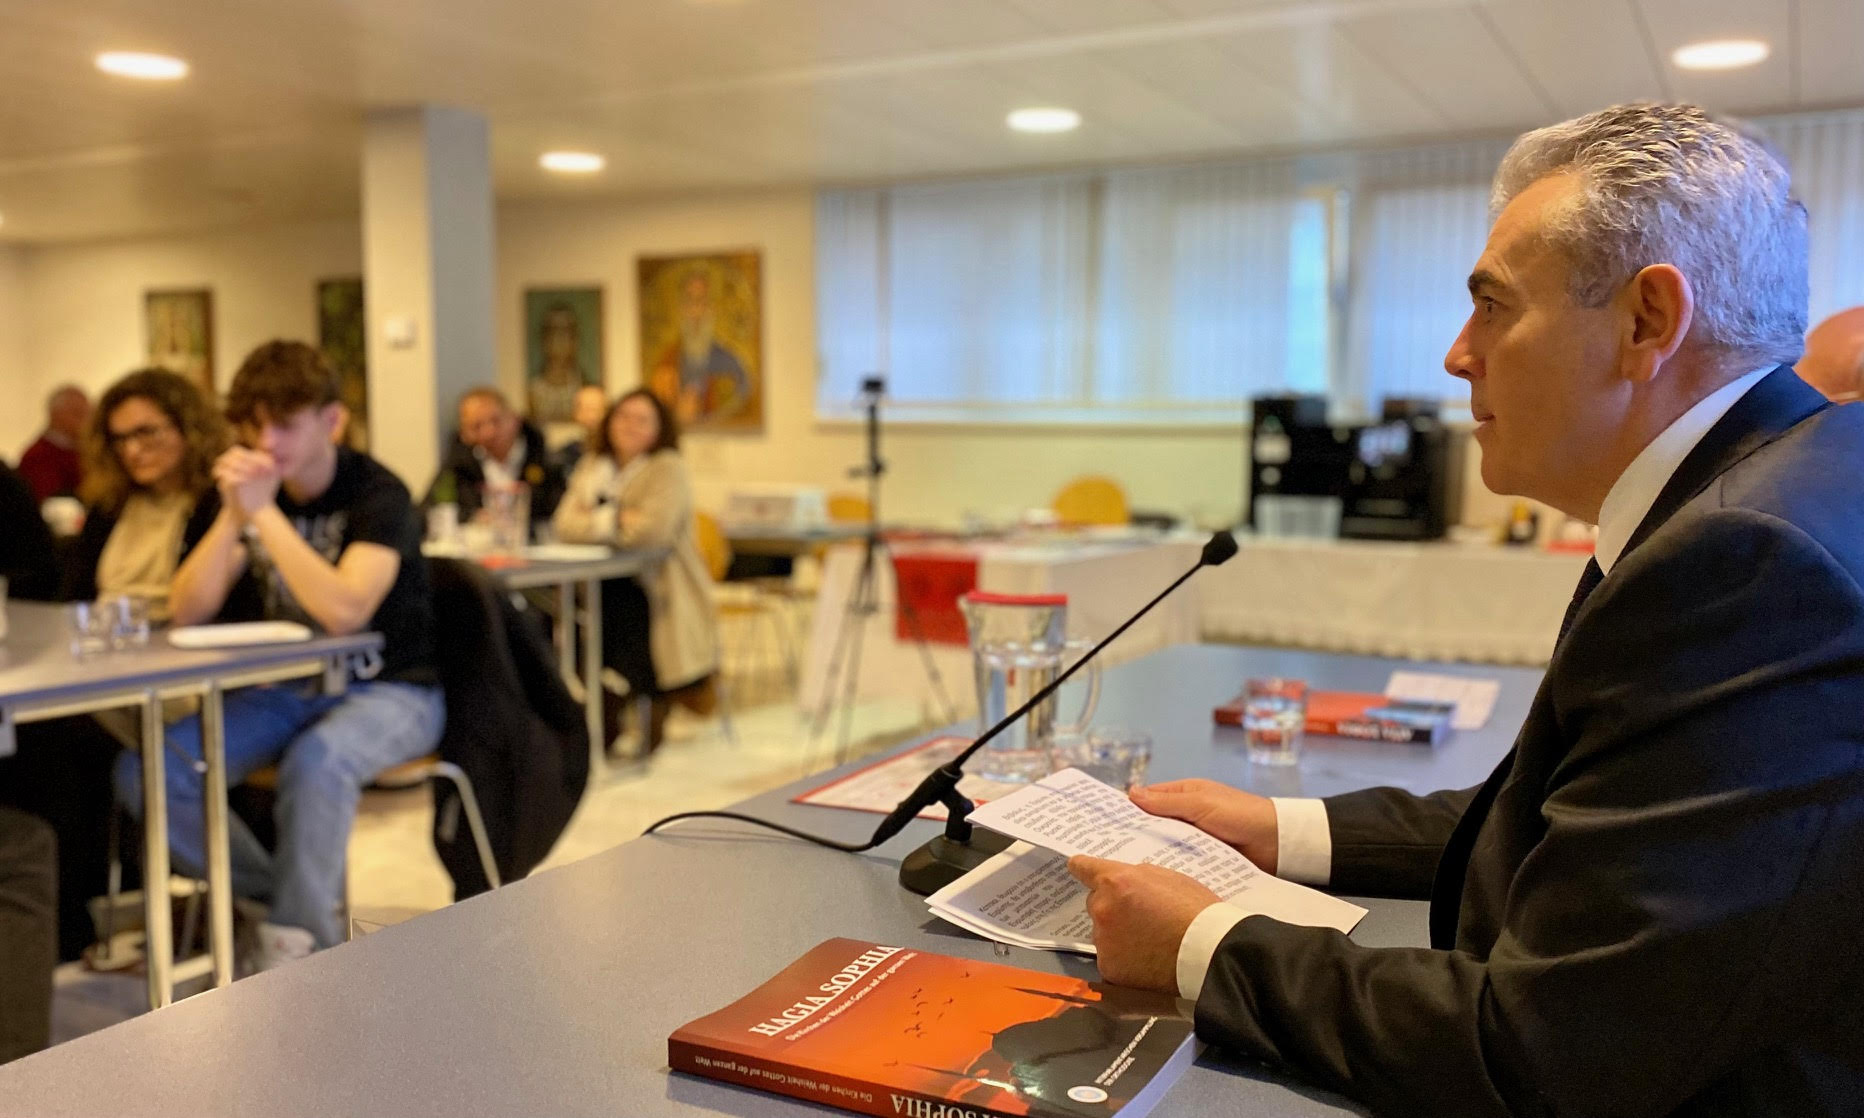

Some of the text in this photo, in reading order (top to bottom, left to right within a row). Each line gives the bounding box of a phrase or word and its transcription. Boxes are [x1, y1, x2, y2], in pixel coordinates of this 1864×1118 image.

[748, 946, 905, 1036] HAGIA SOPHIA
[694, 1055, 873, 1103] Die Kirchen der Weisheit Gottes auf der ganzen Welt
